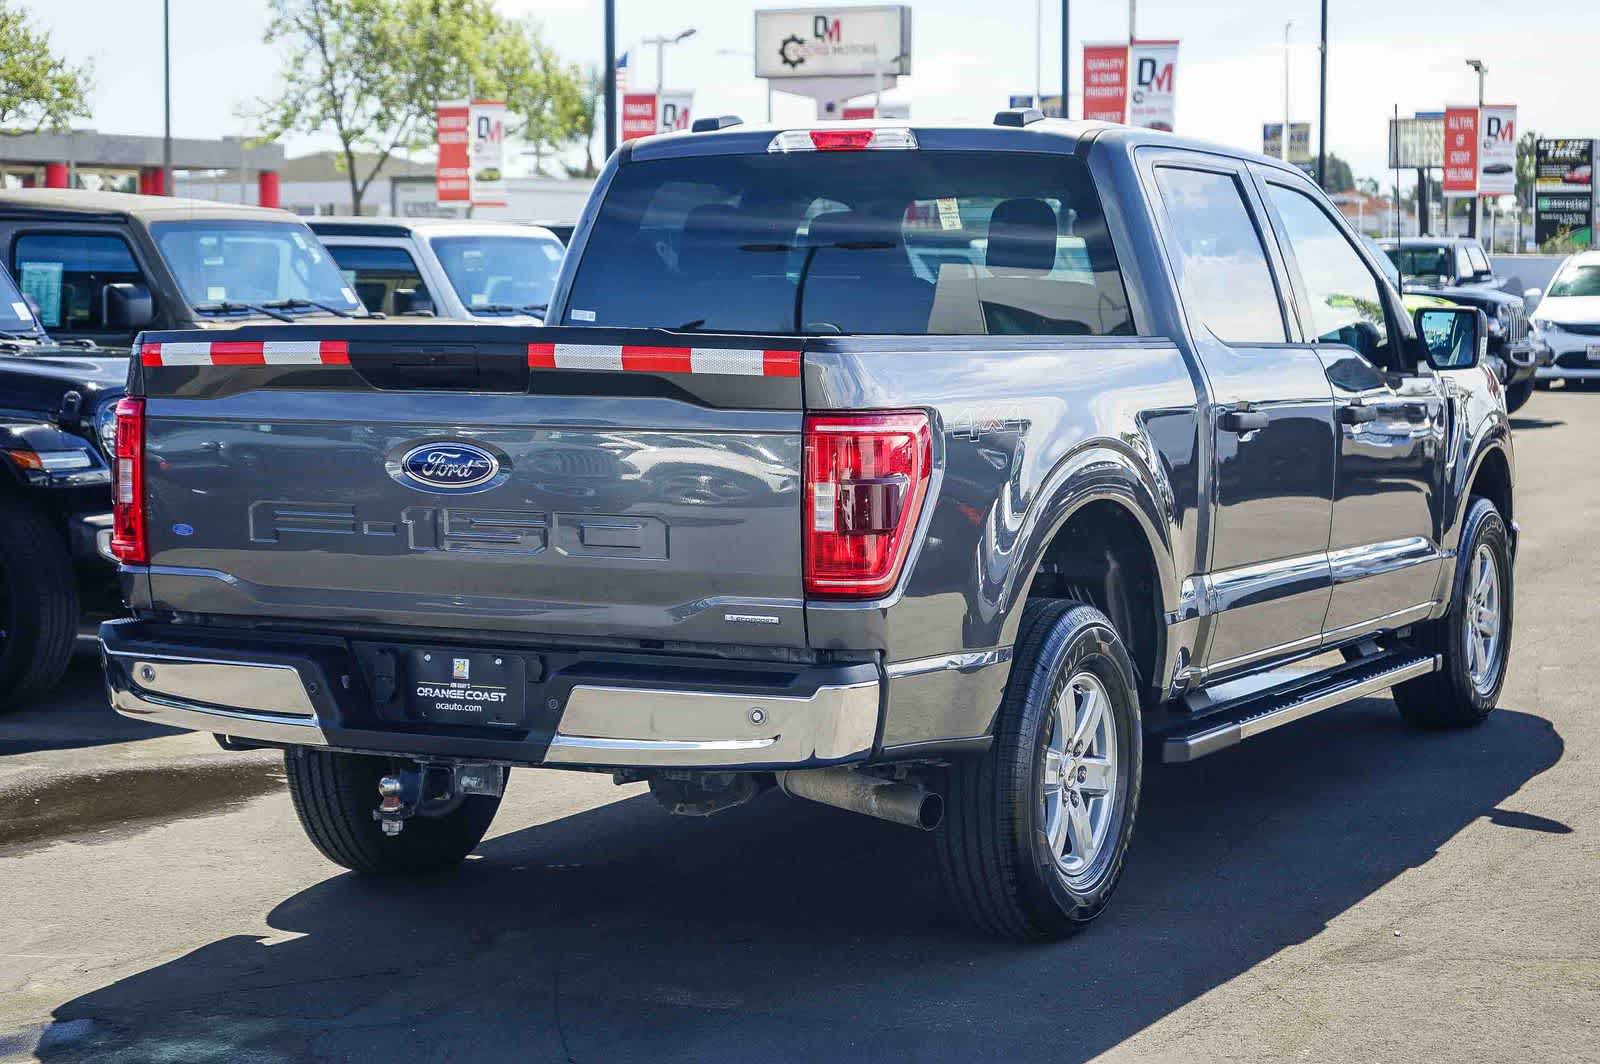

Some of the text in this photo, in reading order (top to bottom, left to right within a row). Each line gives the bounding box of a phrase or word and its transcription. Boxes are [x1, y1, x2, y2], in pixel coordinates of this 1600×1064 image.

[1137, 58, 1173, 93] DM
[1487, 117, 1513, 142] DM
[422, 451, 488, 477] Ford
[248, 500, 671, 561] F-150
[435, 702, 482, 713] ocauto.com
